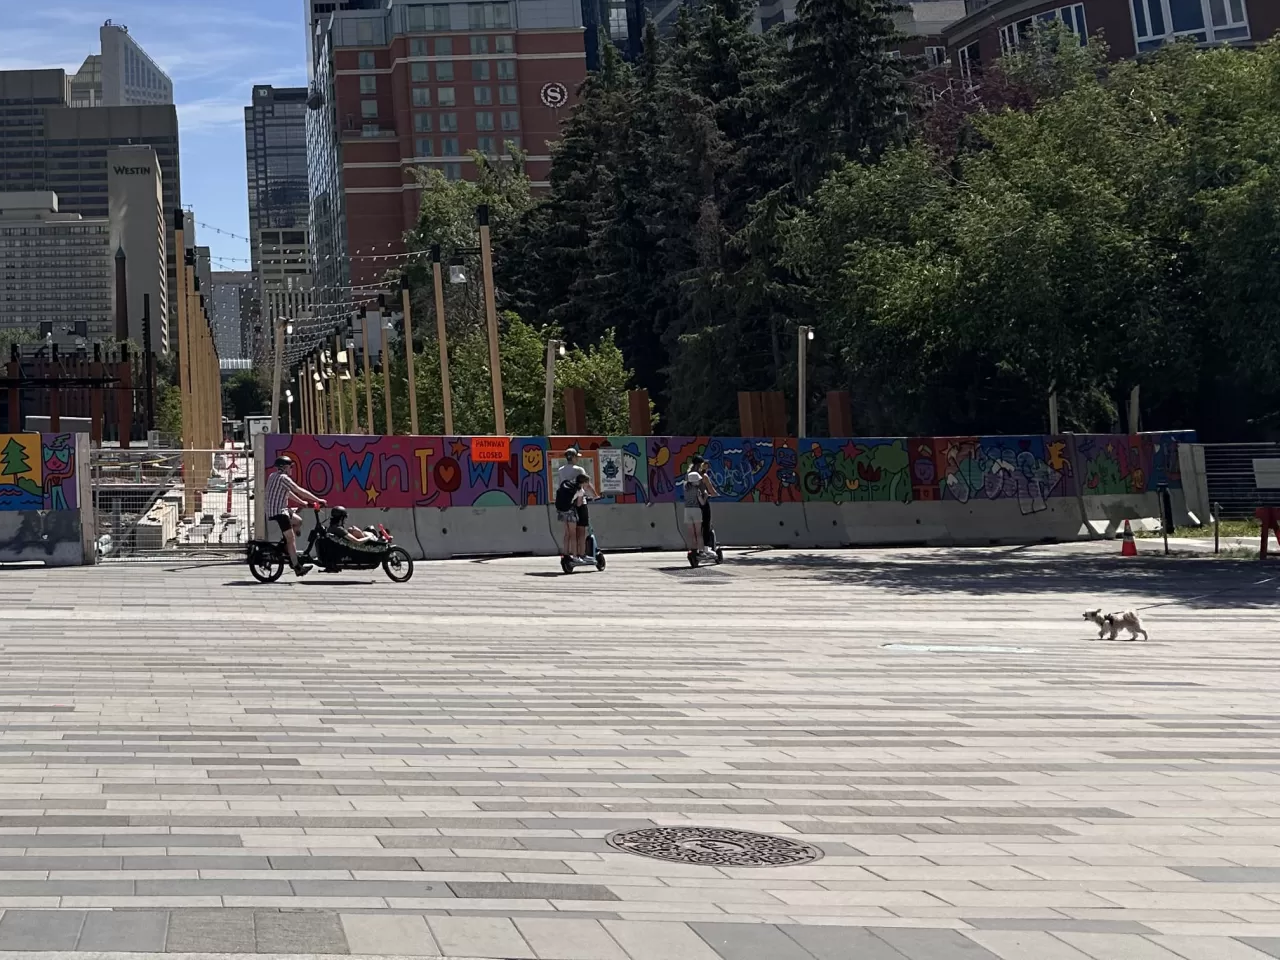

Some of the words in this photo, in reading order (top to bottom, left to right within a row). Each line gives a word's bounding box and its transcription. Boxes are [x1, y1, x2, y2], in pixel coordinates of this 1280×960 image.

[257, 89, 268, 97] TD
[546, 87, 561, 102] S
[112, 165, 150, 176] WESTIN
[475, 440, 505, 448] PATHWAY
[478, 451, 503, 459] CLOSED
